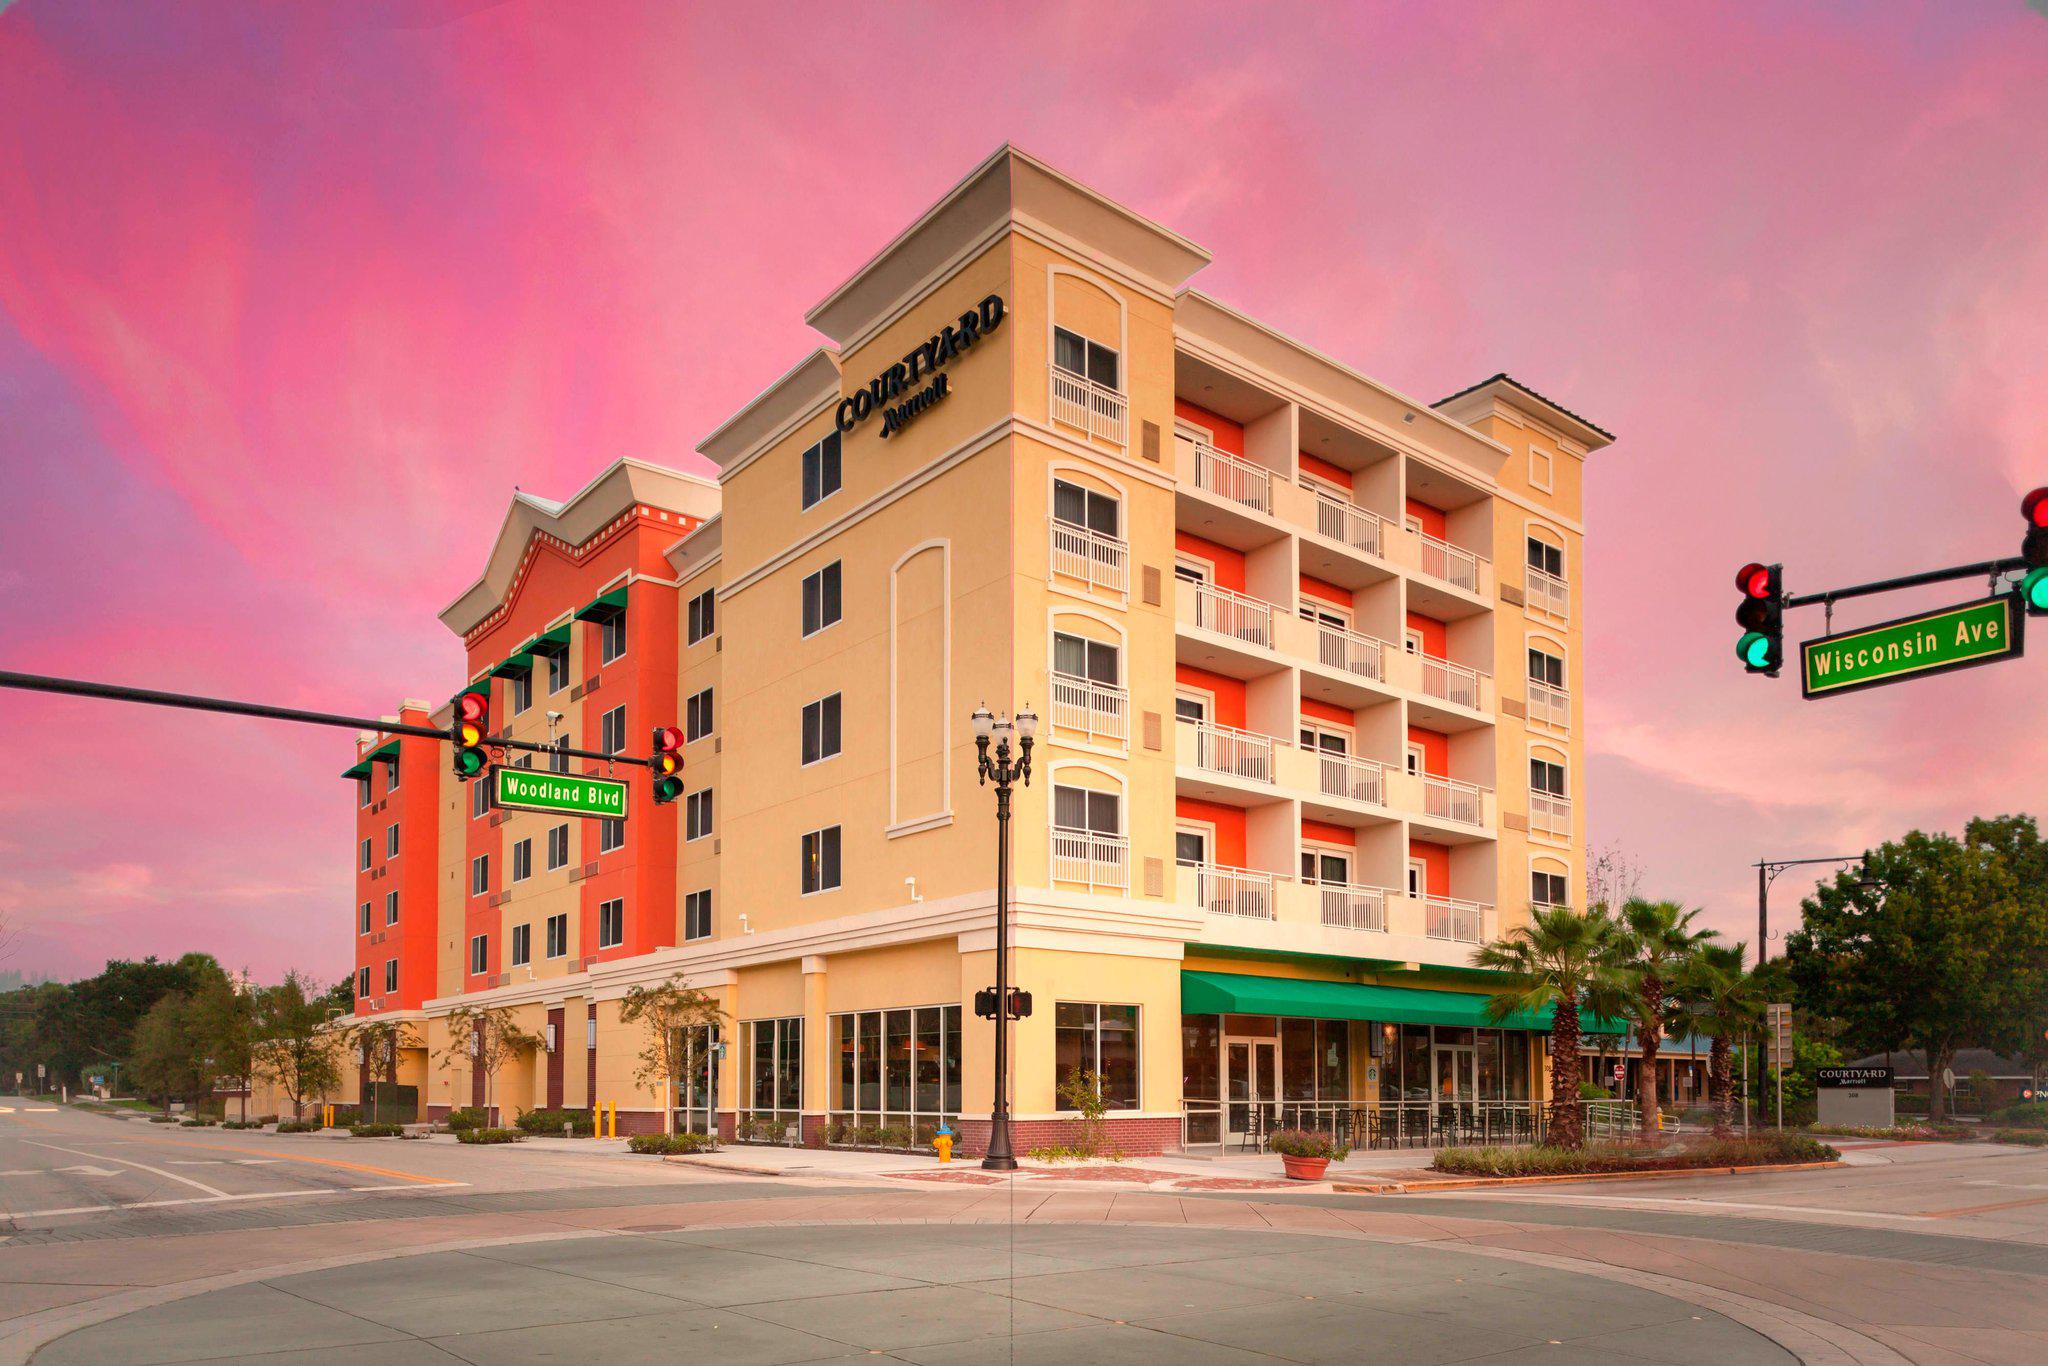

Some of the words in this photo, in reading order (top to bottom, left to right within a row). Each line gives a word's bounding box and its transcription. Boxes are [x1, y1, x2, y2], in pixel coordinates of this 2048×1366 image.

[835, 294, 1004, 432] COURTYARD
[879, 372, 949, 439] Marriott
[1814, 631, 1938, 676] Wisconsin
[1955, 620, 1999, 646] Ave
[507, 777, 579, 802] Woodland
[588, 786, 619, 806] Blvd
[1819, 1069, 1886, 1078] COURTYARD
